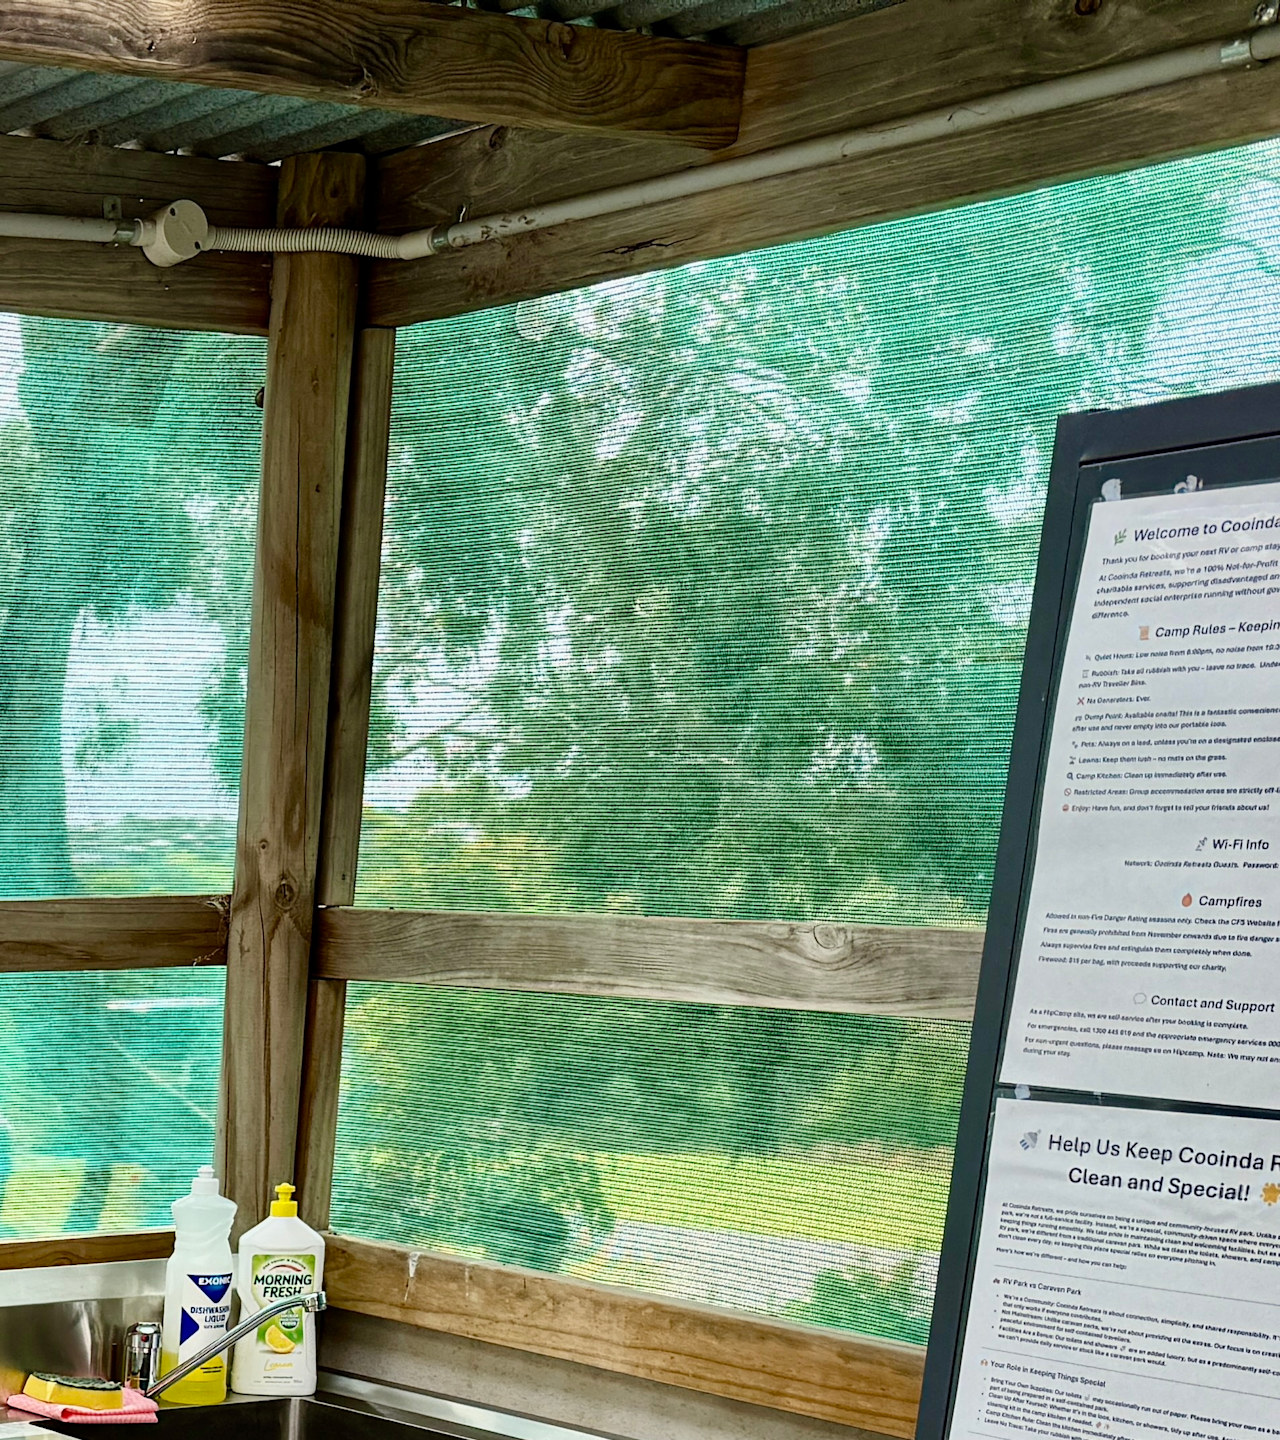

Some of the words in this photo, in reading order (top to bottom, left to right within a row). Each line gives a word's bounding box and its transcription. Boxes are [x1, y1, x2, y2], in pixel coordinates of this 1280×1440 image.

[1134, 525, 1199, 541] Welcome
[1203, 523, 1217, 534] to
[1123, 556, 1137, 565] you
[1149, 551, 1181, 560] booking
[1181, 550, 1199, 559] your
[1217, 546, 1230, 554] RV
[1229, 546, 1239, 554] or
[1239, 544, 1263, 552] camp
[1203, 564, 1224, 573] 100%
[1225, 559, 1278, 571] Not-for-Profit
[1167, 578, 1209, 589] supporting
[1209, 573, 1268, 585] disadvantaged
[1140, 594, 1162, 603] social
[1163, 592, 1202, 601] enterprise
[1203, 589, 1234, 598] running
[1234, 586, 1265, 596] without
[1154, 626, 1190, 638] Camp
[1192, 623, 1226, 635] Rules
[1154, 804, 1174, 812] forget
[1212, 838, 1243, 850] Wi-Fi
[1245, 838, 1269, 850] Info
[1198, 895, 1262, 909] Campfires
[1150, 994, 1198, 1008] Contact
[1199, 998, 1223, 1009] and
[1225, 999, 1275, 1013] Support
[1048, 1133, 1091, 1157] Help
[1096, 1138, 1120, 1156] Us
[1125, 1141, 1172, 1165] Keep
[1178, 1146, 1264, 1170] Cooinda
[1068, 1167, 1122, 1188] Clean
[1127, 1175, 1164, 1192] and
[1167, 1177, 1250, 1201] Special!
[254, 1274, 312, 1286] MORNING
[1002, 1277, 1012, 1285] RV
[1012, 1278, 1027, 1287] Park
[1037, 1282, 1065, 1293] Caravan
[1065, 1286, 1081, 1295] Park
[263, 1286, 302, 1298] FRESH
[990, 1359, 1005, 1368] Your
[1005, 1362, 1021, 1372] Role
[1029, 1367, 1056, 1380] Keeping
[1057, 1371, 1078, 1383] Things
[1079, 1376, 1106, 1388] Special
